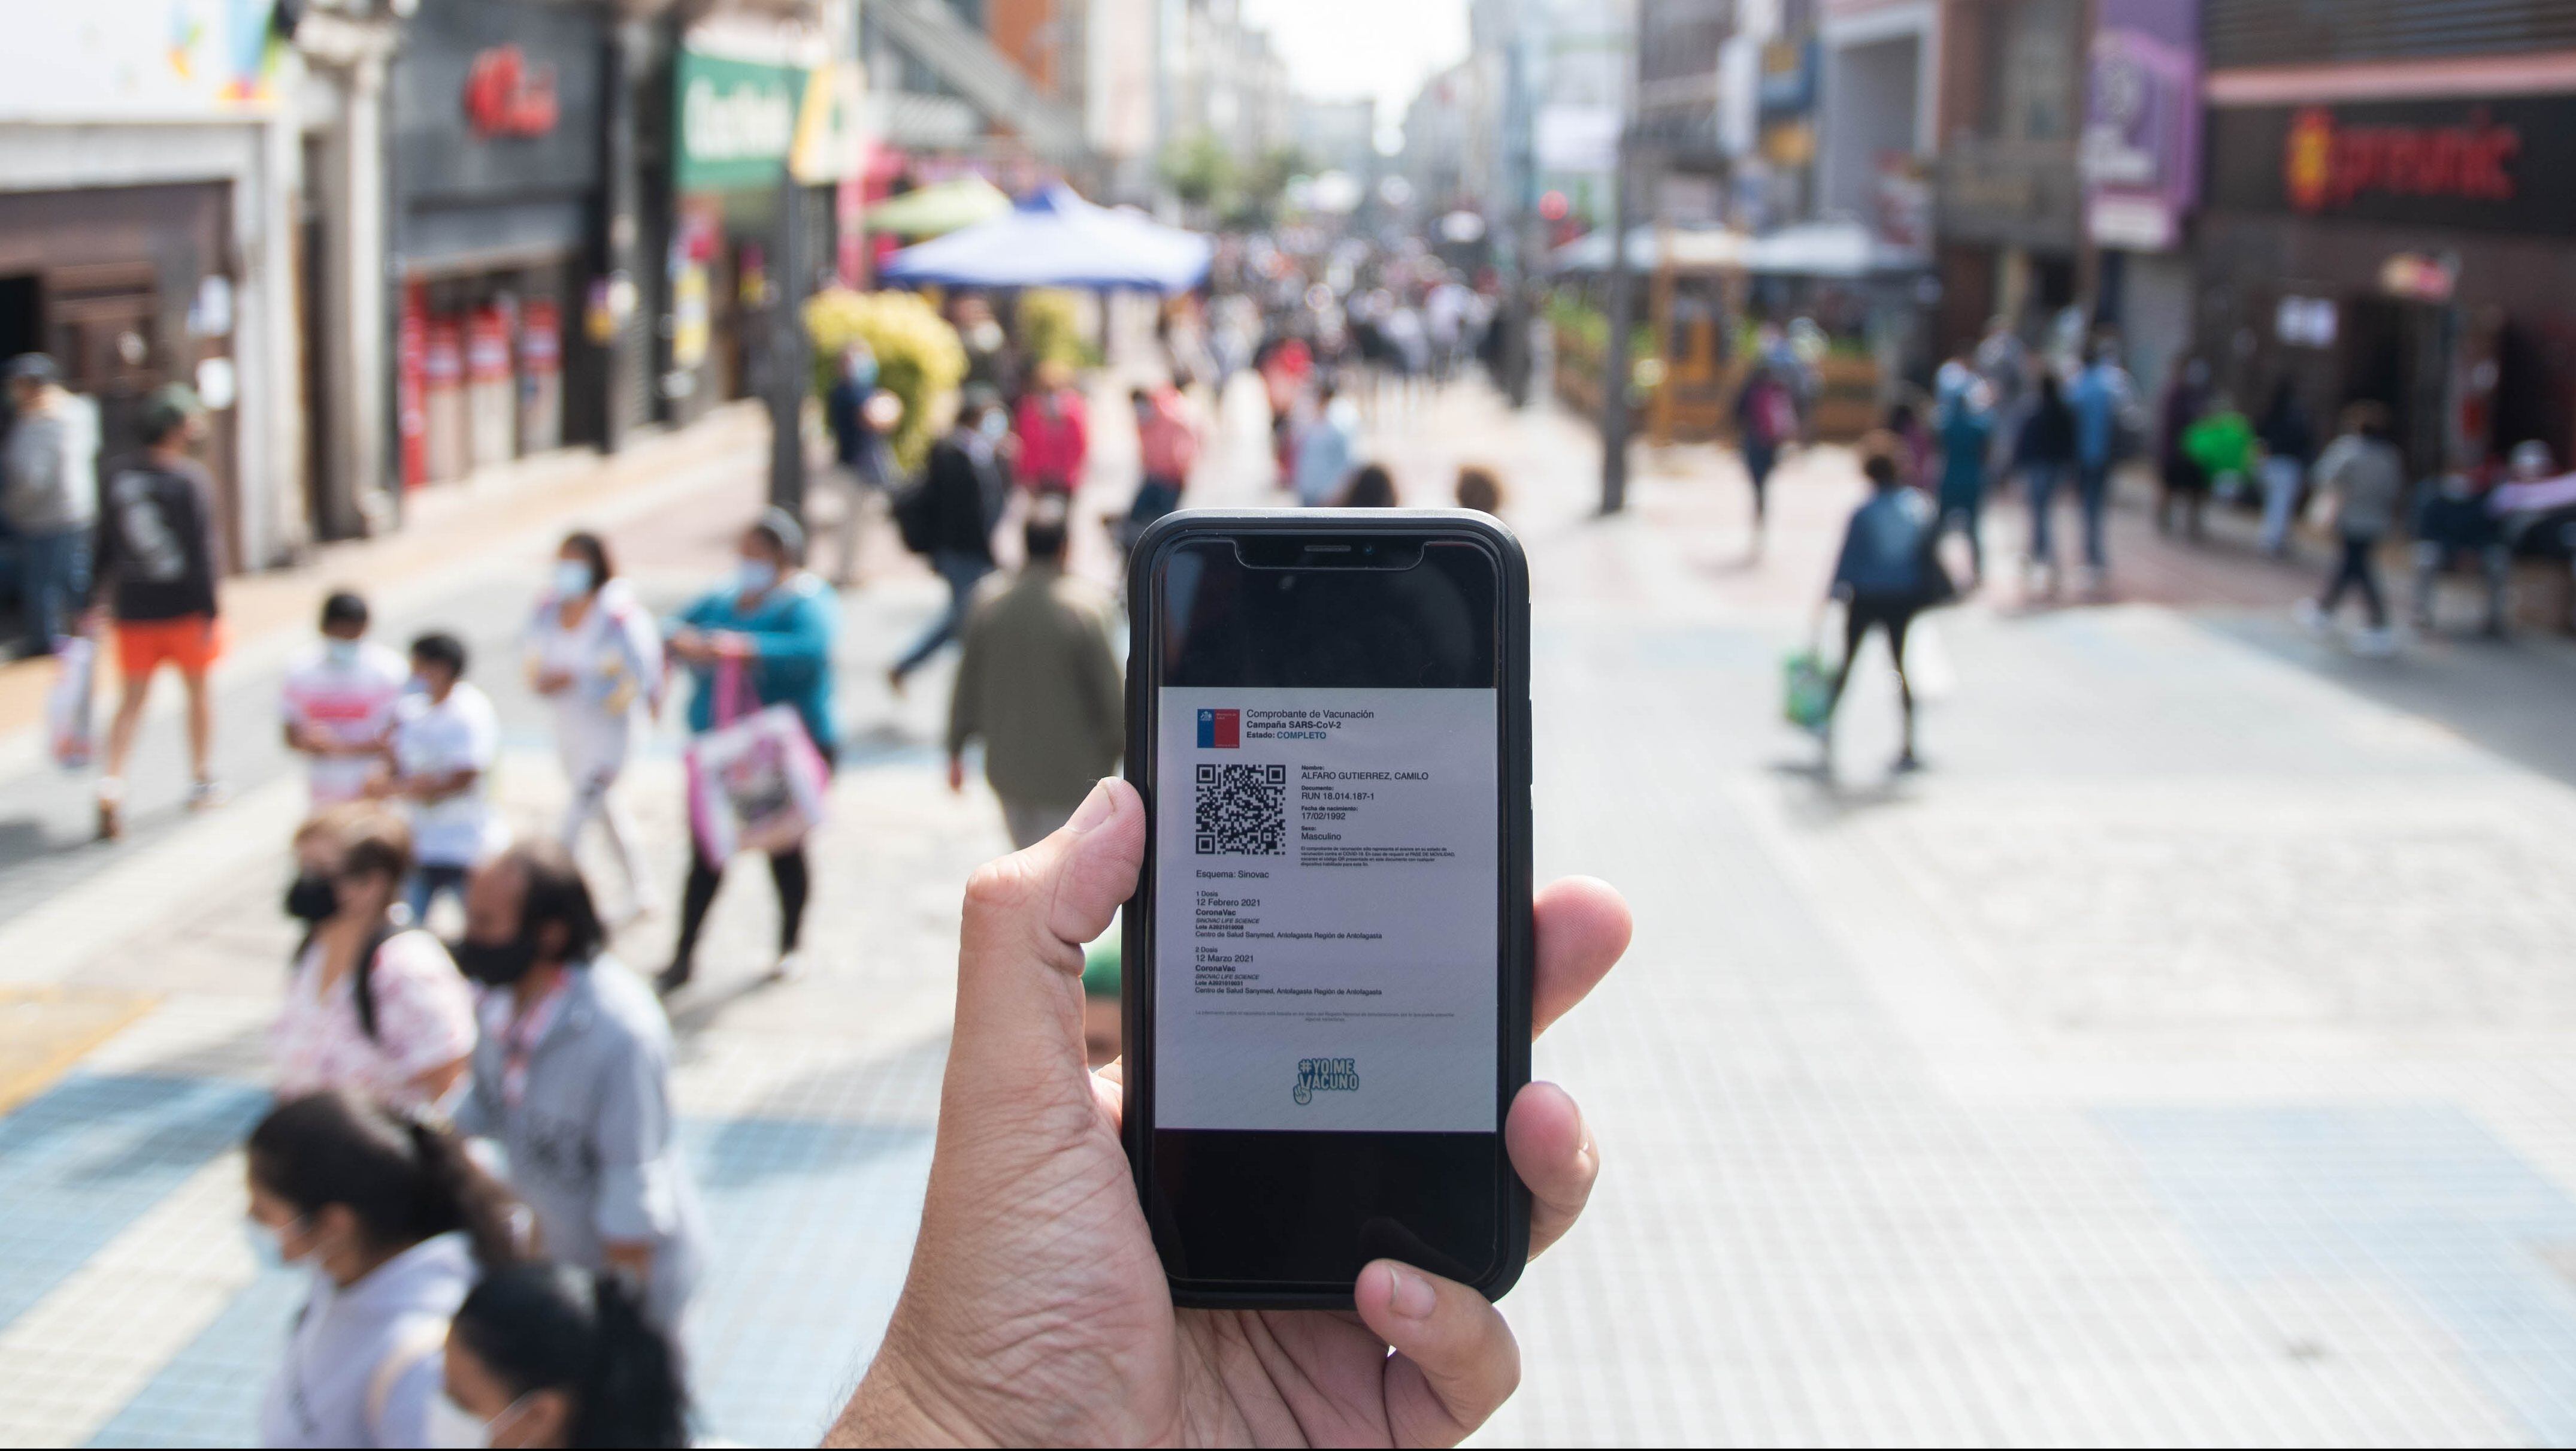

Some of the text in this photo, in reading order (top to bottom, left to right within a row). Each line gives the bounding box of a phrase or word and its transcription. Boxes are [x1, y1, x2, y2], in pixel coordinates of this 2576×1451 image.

[1246, 709, 1374, 719] Comprobante de Vacunación
[1246, 721, 1286, 729] Campaña
[1246, 731, 1327, 739] Estado: COMPLETO
[1339, 772, 1392, 781] GUTIERREZ,
[1196, 870, 1269, 879] Esquema: Sinovac
[1314, 932, 1336, 940] Región
[1298, 1059, 1355, 1074] #YO ME
